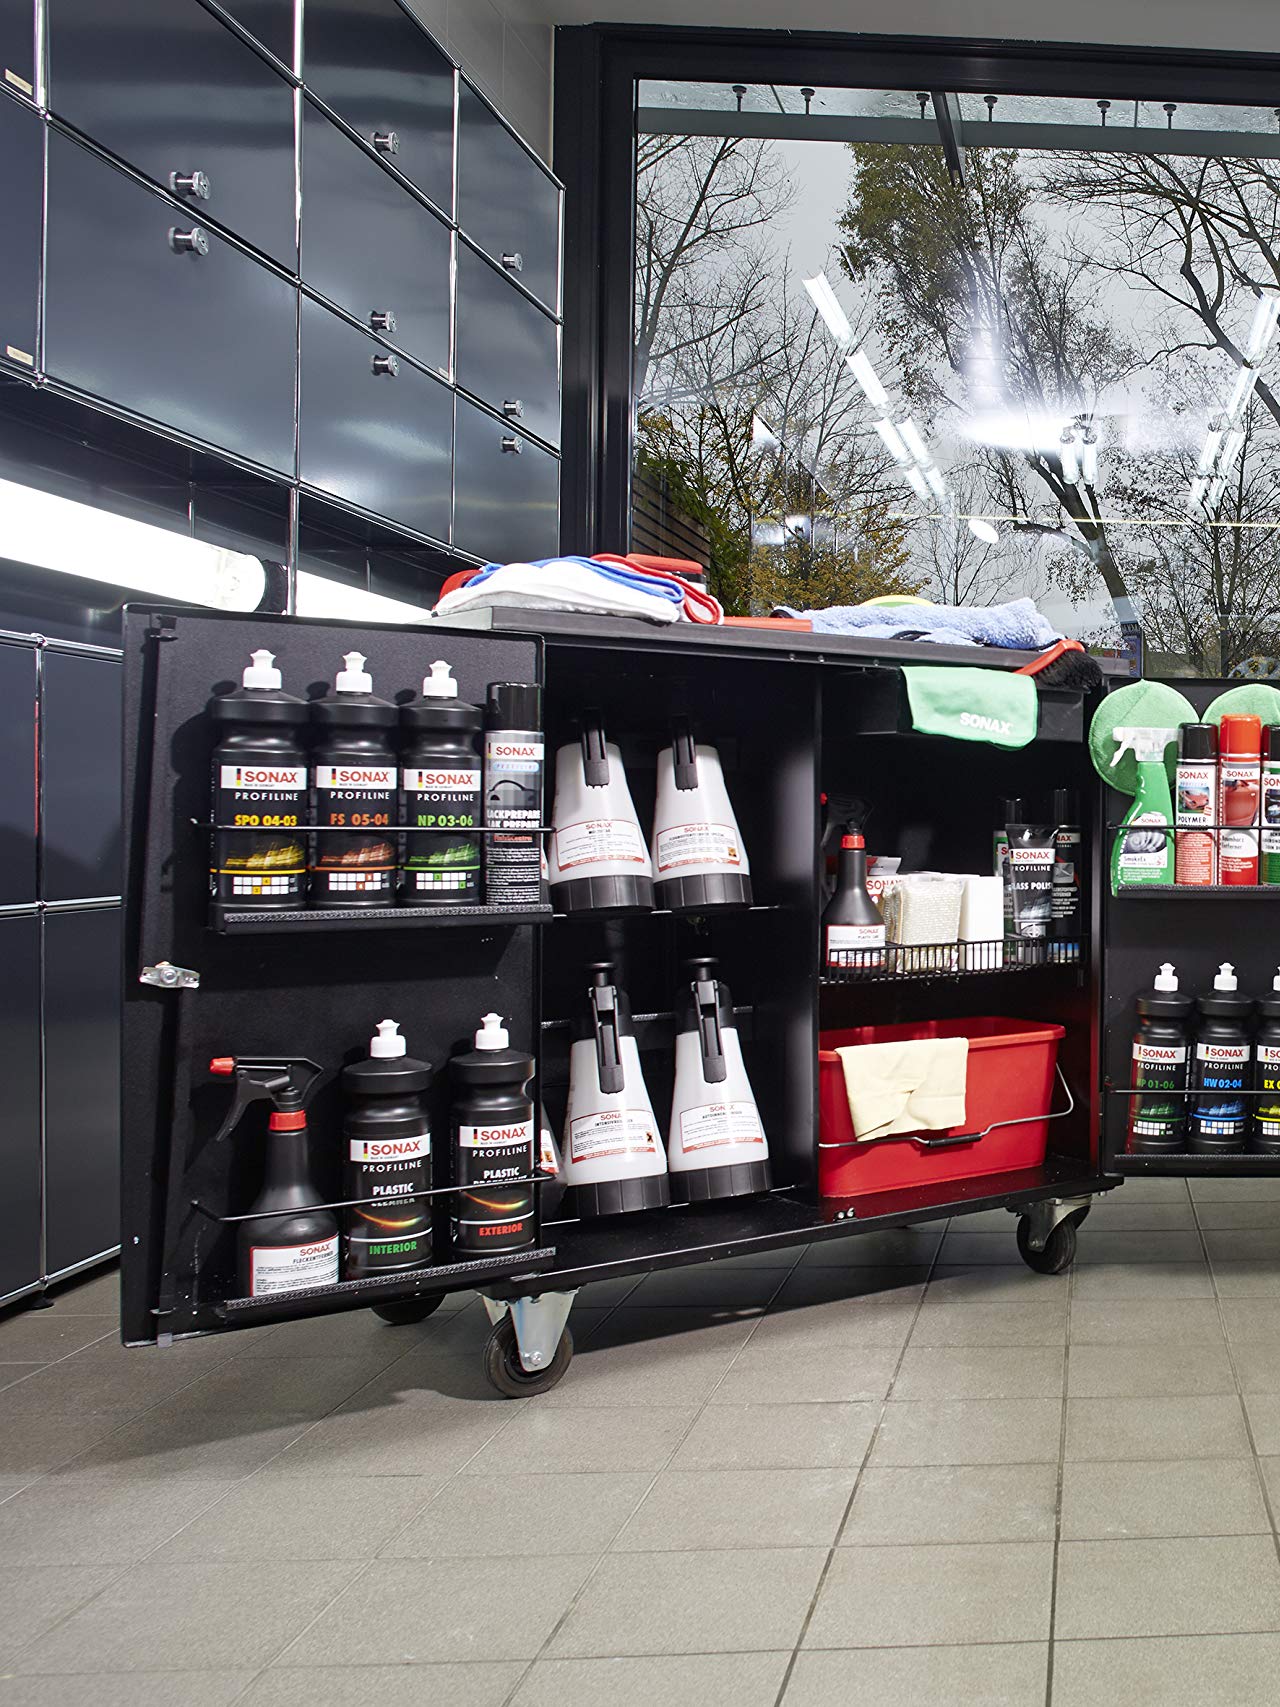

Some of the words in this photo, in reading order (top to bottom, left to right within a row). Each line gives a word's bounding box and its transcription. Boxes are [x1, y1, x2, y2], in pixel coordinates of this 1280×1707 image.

[960, 711, 1011, 736] SONAX
[496, 746, 535, 756] SONAX
[245, 771, 297, 783] SONAX
[340, 770, 389, 782] SONAX
[425, 773, 473, 785] SONAX
[1179, 771, 1209, 779] SONAX
[235, 792, 298, 800] PROFILINE
[330, 791, 390, 800] PROFILINE
[417, 793, 474, 801] PROFILINE
[235, 814, 260, 826] SPO
[262, 815, 297, 827] 04-03
[330, 813, 345, 825] FS
[351, 813, 389, 825] 05-04
[417, 815, 436, 826] NP
[438, 815, 473, 826] 03-06
[1015, 851, 1050, 860] SONAX
[1143, 1048, 1176, 1058] SONAX
[1210, 1048, 1243, 1057] SONAX
[1137, 1062, 1176, 1071] PROFILINE
[1204, 1062, 1243, 1070] PROFILINE
[1147, 1079, 1175, 1089] 01-06
[1204, 1078, 1218, 1087] HW
[1218, 1079, 1242, 1088] 02-04
[1264, 1080, 1274, 1089] EX
[481, 1126, 526, 1141] SONAX
[371, 1140, 421, 1155] SONAX
[472, 1145, 527, 1157] PROFILINE
[362, 1160, 422, 1173] PROFILINE
[484, 1166, 520, 1179] PLASTIC
[372, 1183, 414, 1196] PLASTIC
[479, 1223, 523, 1236] EXTERIOR
[300, 1242, 331, 1257] SONAX
[369, 1241, 417, 1255] INTERIOR
